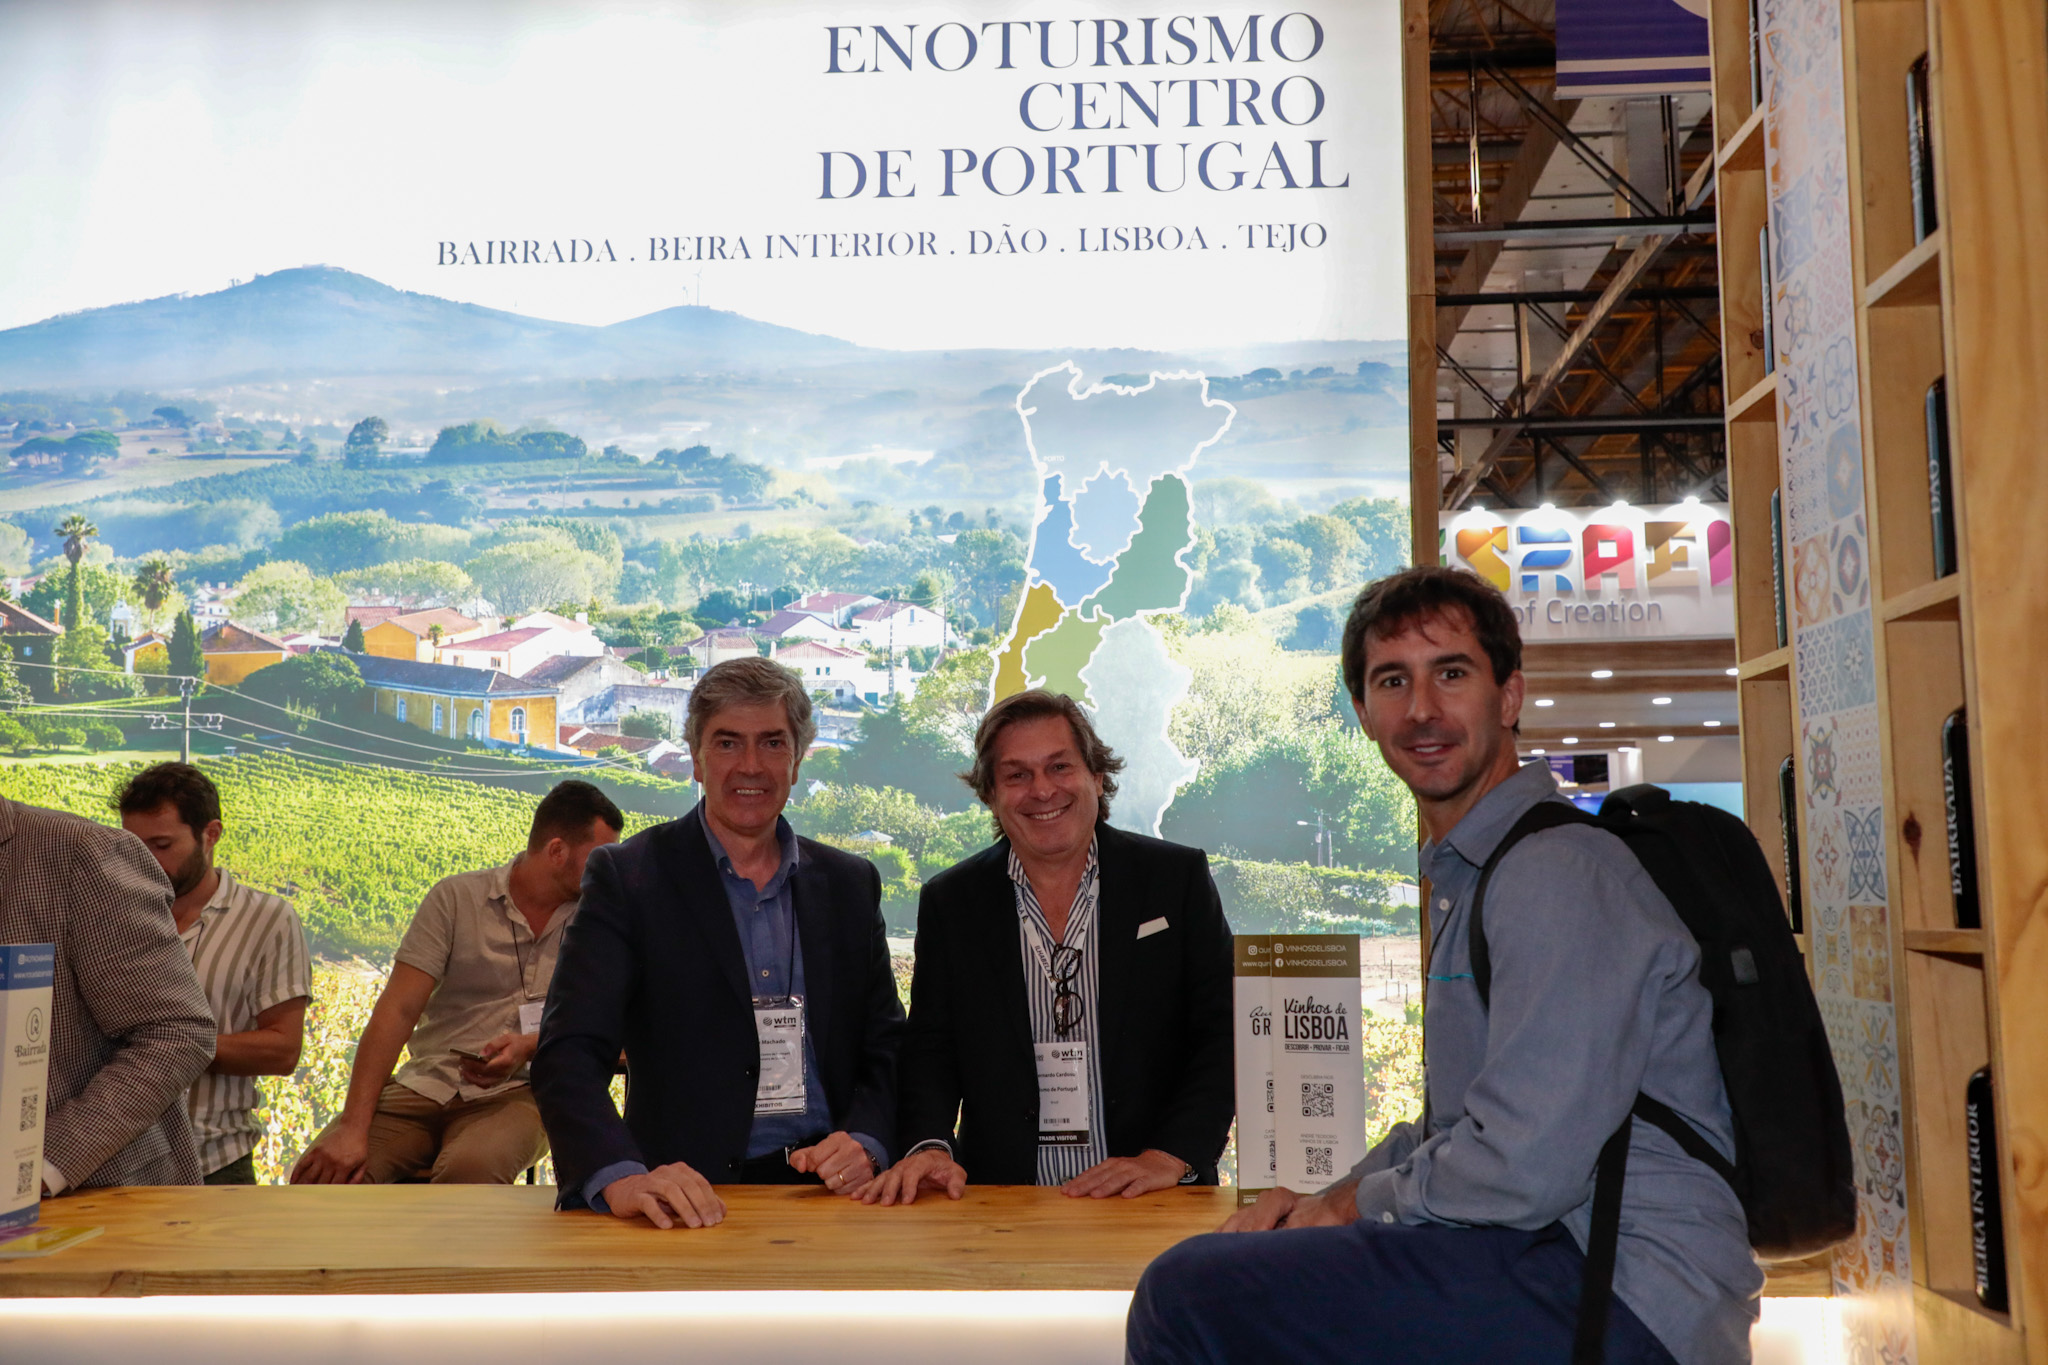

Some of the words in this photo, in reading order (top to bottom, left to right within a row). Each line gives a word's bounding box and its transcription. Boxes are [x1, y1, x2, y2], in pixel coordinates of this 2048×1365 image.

[822, 12, 1326, 74] ENOTURISMO
[1018, 76, 1326, 132] CENTRO
[816, 150, 917, 200] DE
[937, 140, 1350, 197] PORTUGAL
[437, 240, 617, 266] BAIRRADA
[648, 236, 753, 262] BEIRA
[764, 232, 940, 259] INTERIOR
[968, 223, 1048, 255] DÃO
[1078, 226, 1210, 253] LISBOA
[1238, 223, 1329, 253] TEJO
[1546, 597, 1663, 625] Creation
[1944, 757, 1963, 896] BAIRRADA
[1286, 959, 1348, 967] VINHOSDELISBOA
[774, 1016, 797, 1024] wtm
[1284, 995, 1332, 1015] Vinhos
[1335, 1002, 1348, 1015] de
[1284, 1015, 1349, 1040] LISBOA
[1968, 1103, 1985, 1215] INTERIOR
